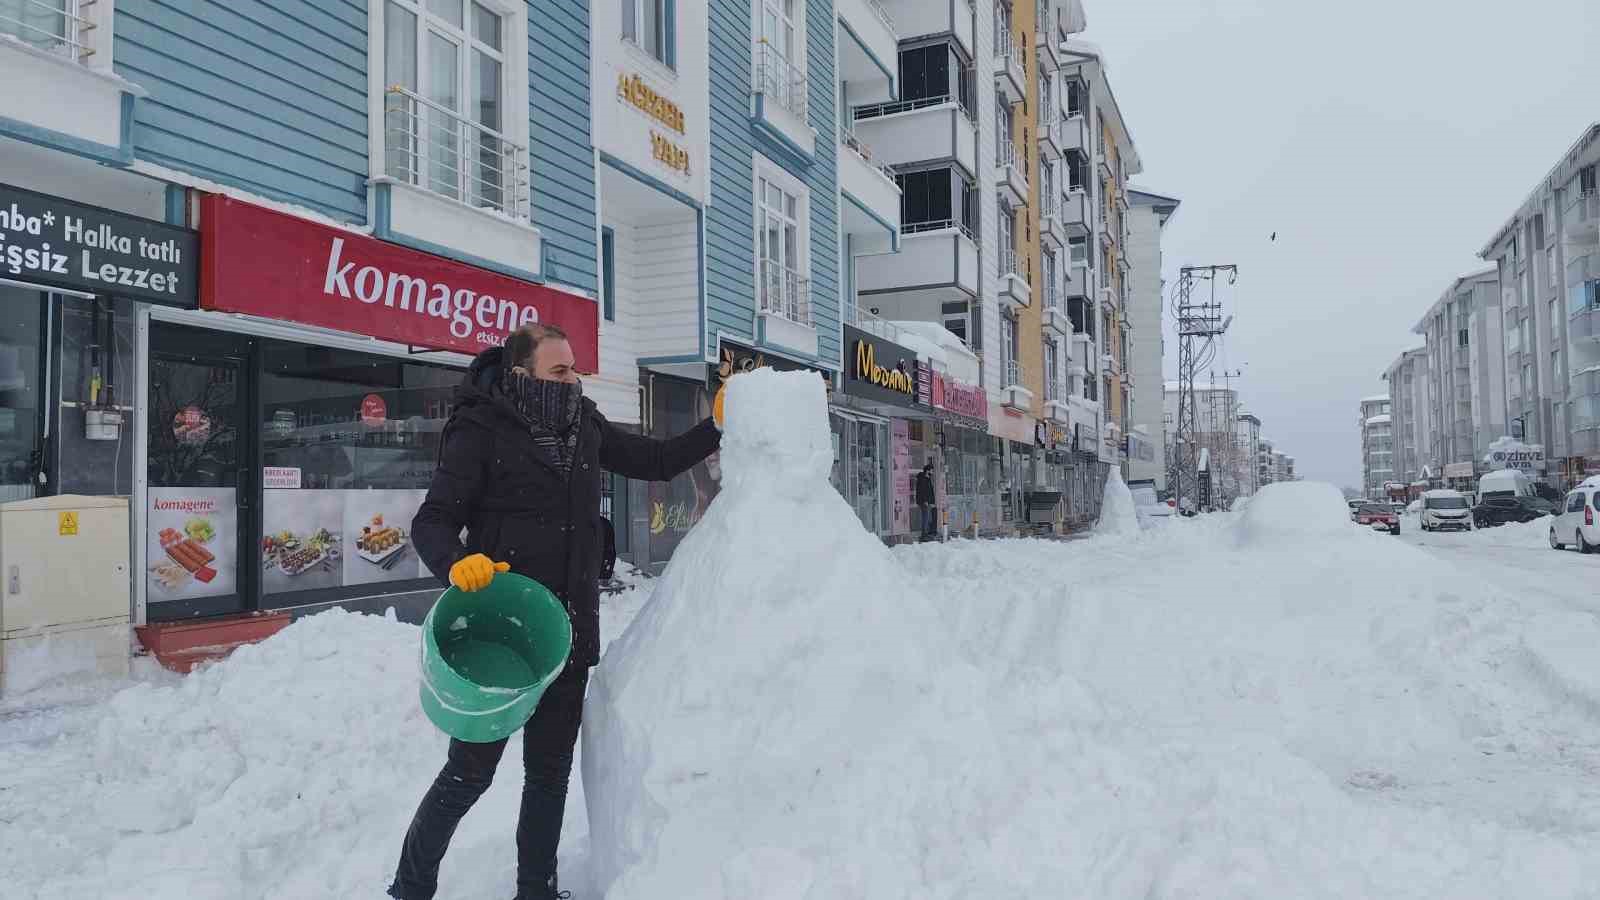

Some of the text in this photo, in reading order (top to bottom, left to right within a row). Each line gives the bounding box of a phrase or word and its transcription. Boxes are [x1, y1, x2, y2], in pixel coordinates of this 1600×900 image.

[64, 215, 131, 254] Halka
[139, 236, 181, 264] tatlı
[81, 249, 178, 294] Lezzet
[323, 236, 539, 339] komagene
[153, 495, 215, 513] komagene
